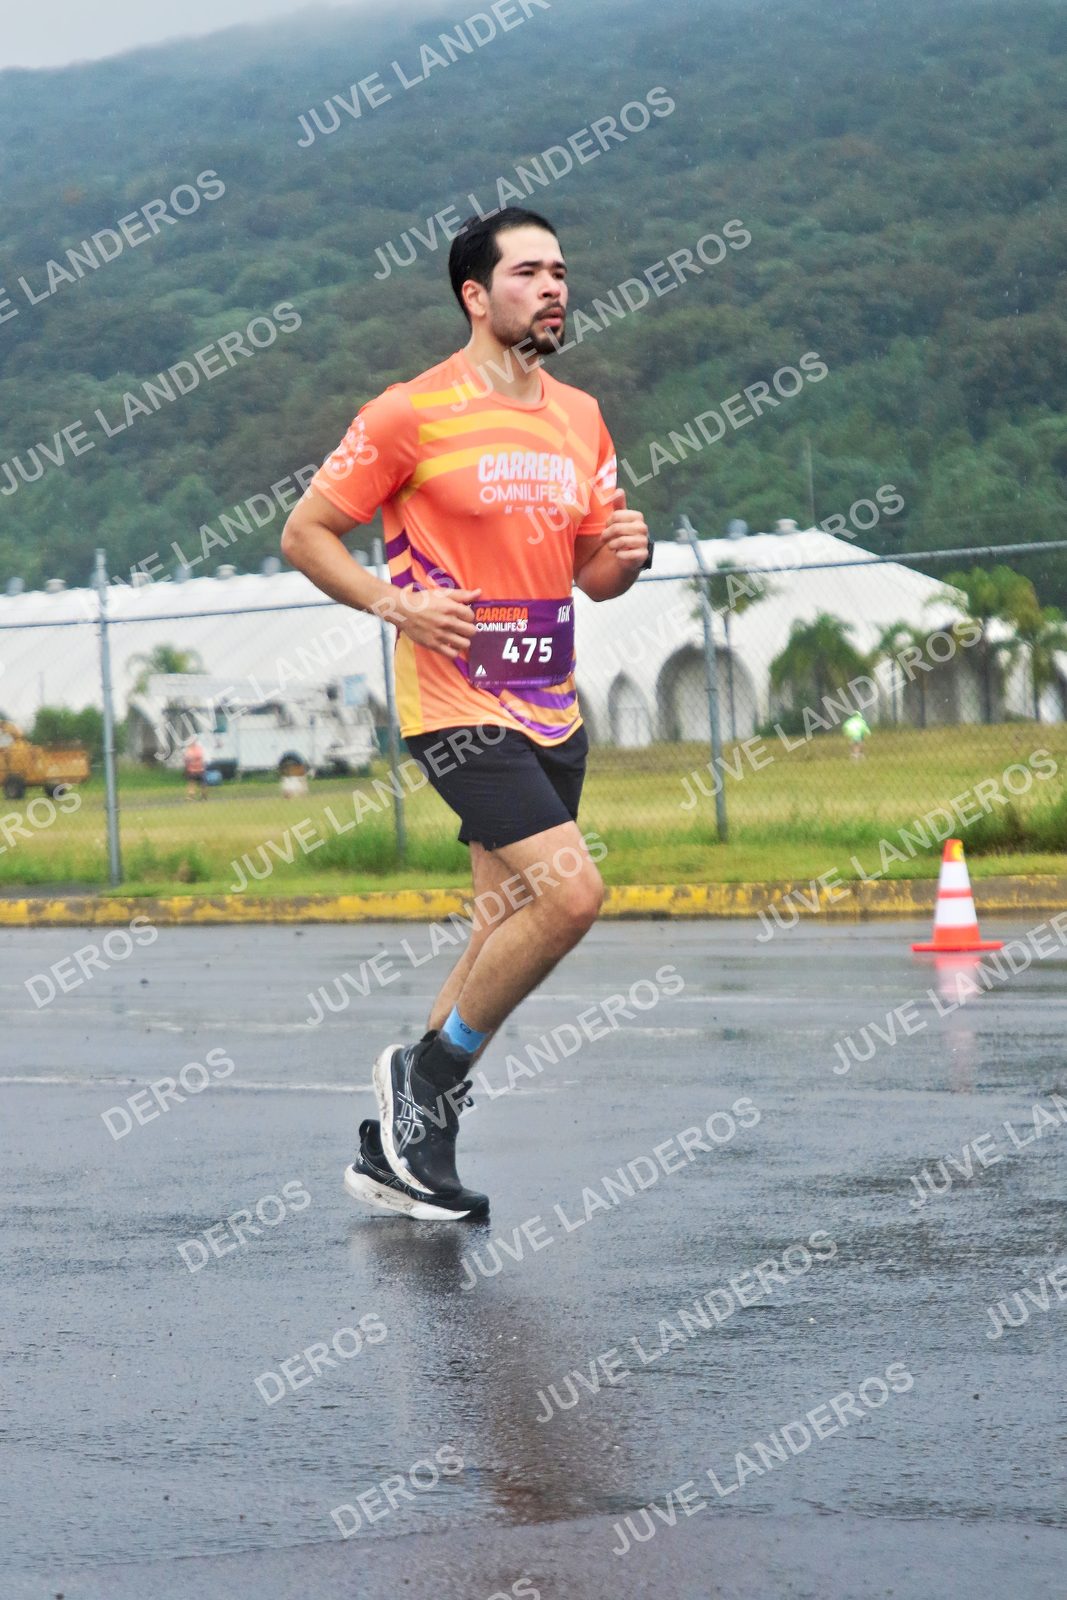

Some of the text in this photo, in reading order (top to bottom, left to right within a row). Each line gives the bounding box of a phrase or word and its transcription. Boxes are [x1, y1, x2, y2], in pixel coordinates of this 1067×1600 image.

[478, 451, 577, 483] CARRERA
[475, 607, 528, 622] CARRERA
[502, 637, 553, 664] 475
